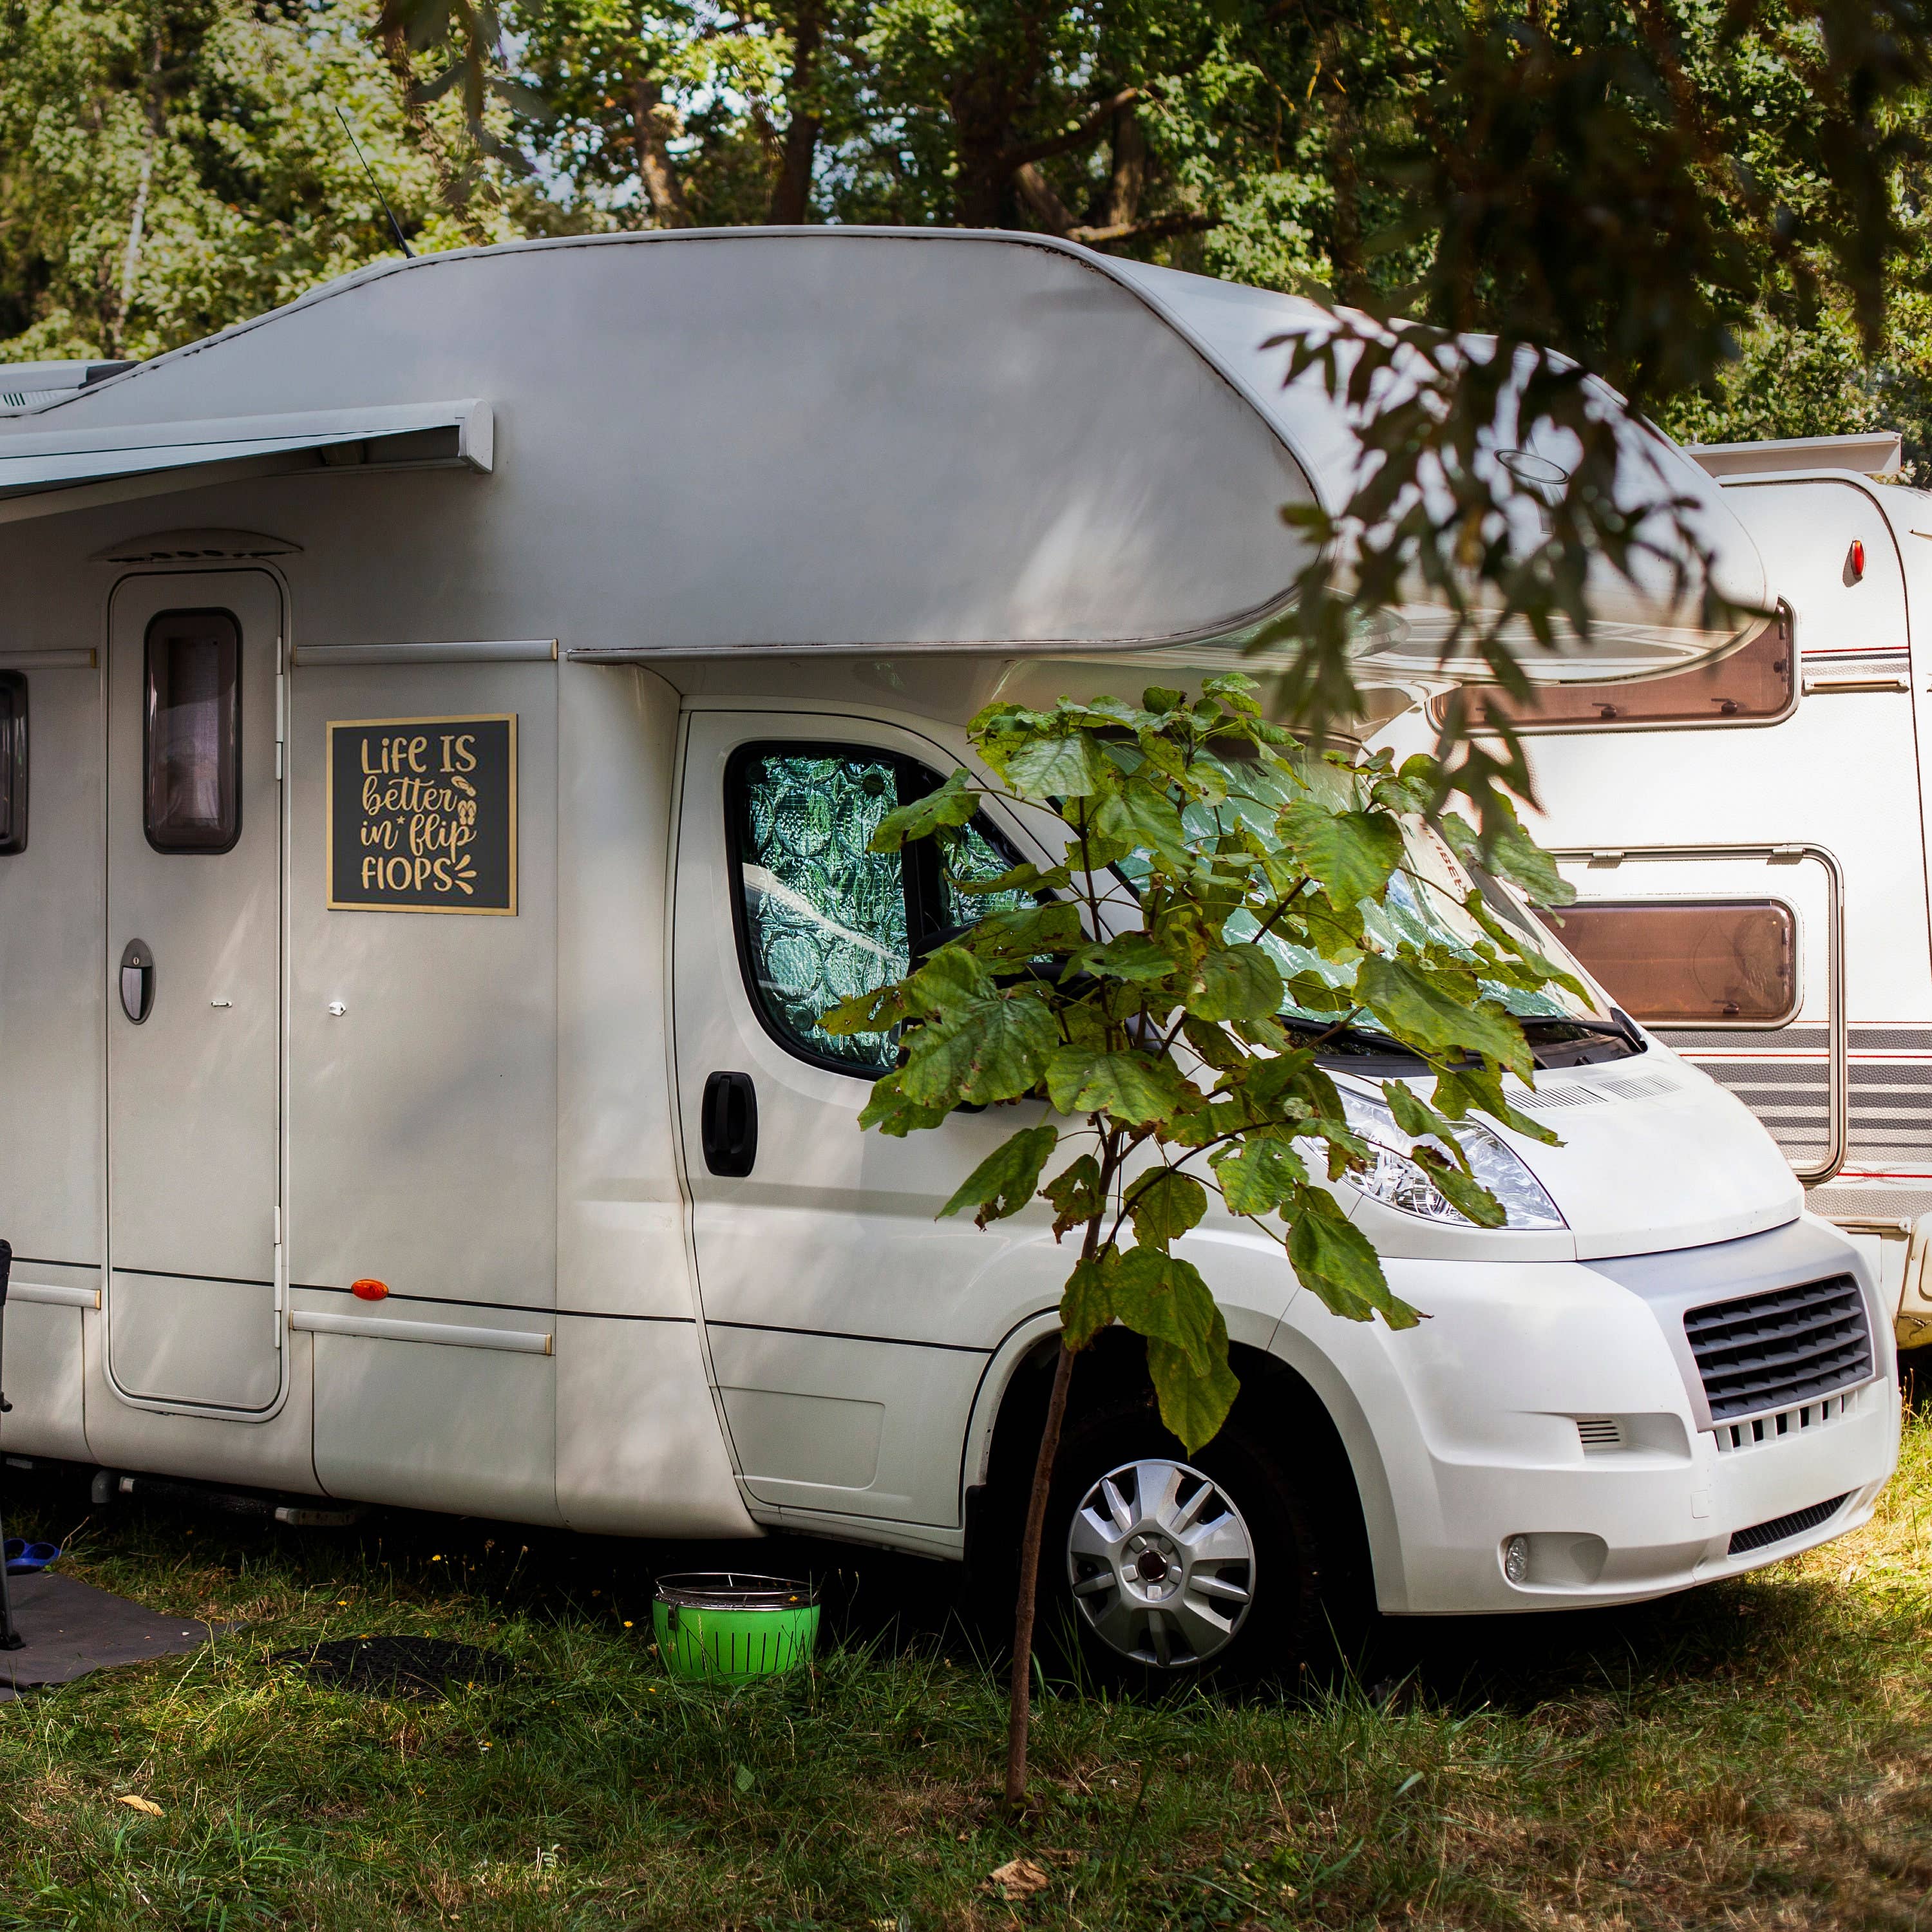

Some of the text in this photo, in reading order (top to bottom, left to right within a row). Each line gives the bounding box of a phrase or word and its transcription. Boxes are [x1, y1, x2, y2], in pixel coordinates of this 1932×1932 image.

[439, 734, 477, 773] IS
[362, 775, 459, 816] better
[360, 813, 477, 864] in flip
